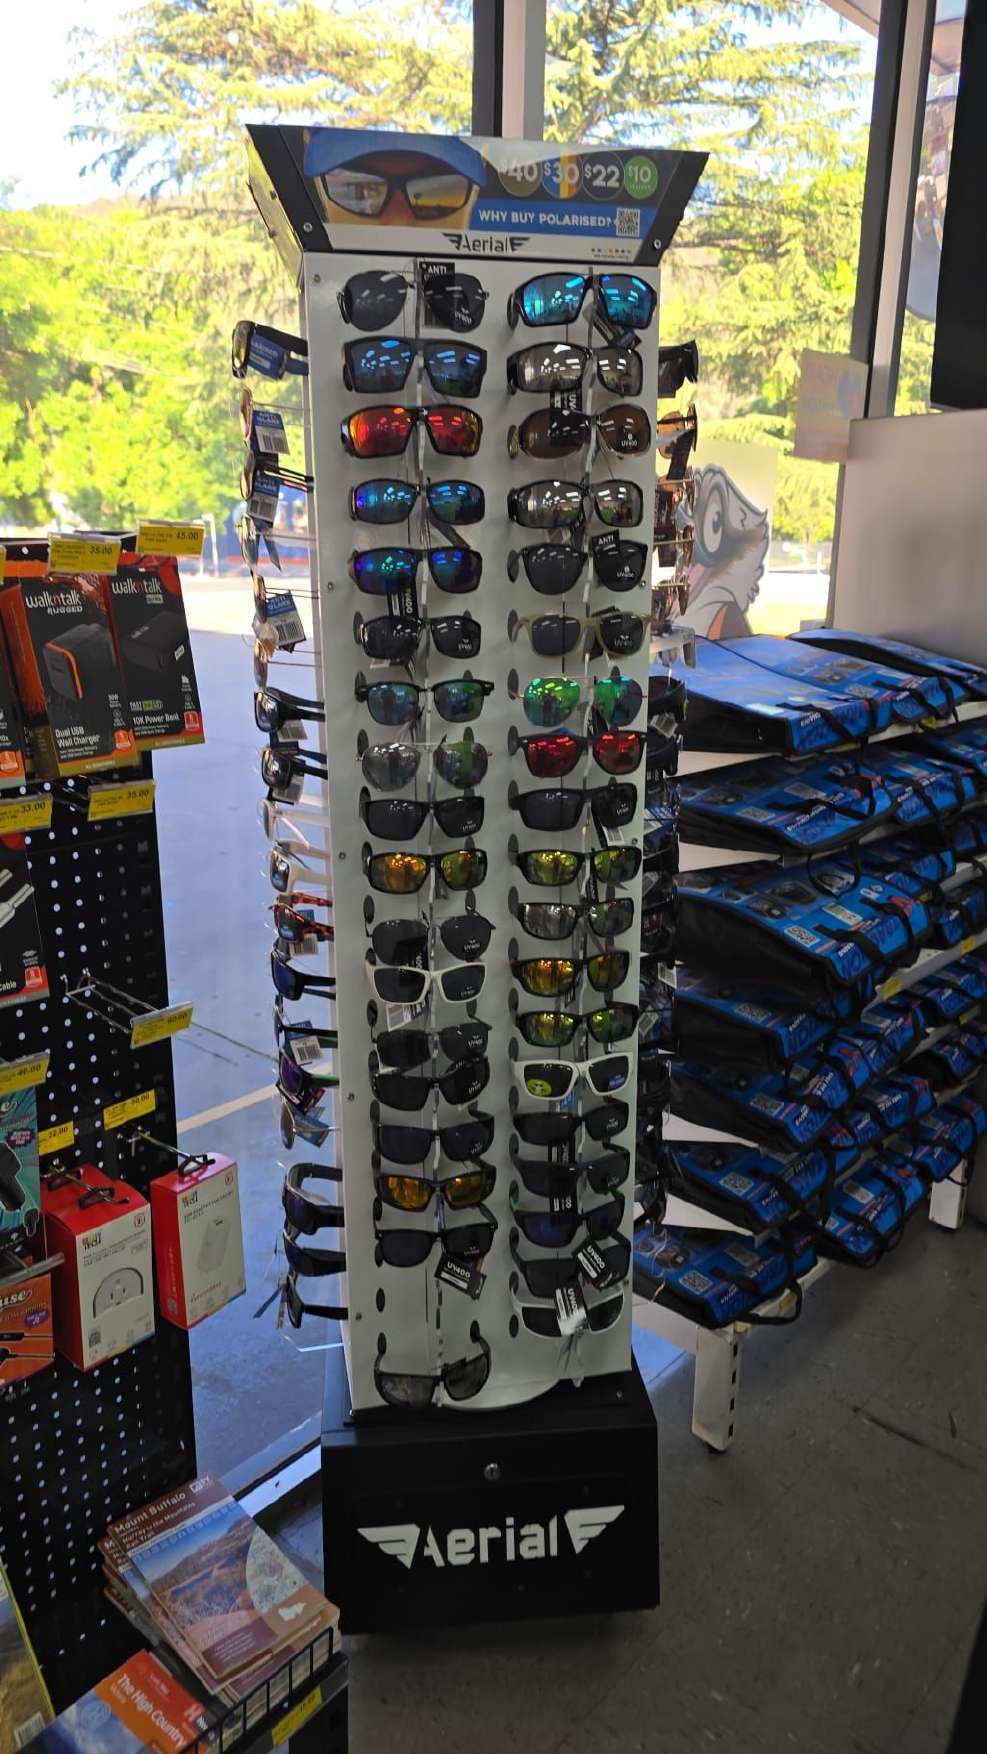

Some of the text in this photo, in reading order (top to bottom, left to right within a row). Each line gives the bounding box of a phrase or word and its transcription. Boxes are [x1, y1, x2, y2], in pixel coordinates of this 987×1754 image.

[543, 162, 580, 184] $30
[584, 164, 620, 188] $22
[628, 165, 652, 183] $10
[478, 209, 612, 227] WHY BUY POLARISED?
[462, 233, 508, 252] Aerial
[428, 265, 447, 275] ANTI
[598, 535, 614, 545] ANTI
[47, 605, 83, 615] RUGGED
[144, 714, 164, 724] Power
[57, 734, 100, 748] Wall Charger
[447, 1261, 471, 1278] UV400
[114, 1492, 186, 1534] Mount Buffalo
[424, 1513, 558, 1568] Aerial
[117, 1673, 135, 1696] The
[131, 1690, 154, 1714] High
[151, 1709, 187, 1749] Country
